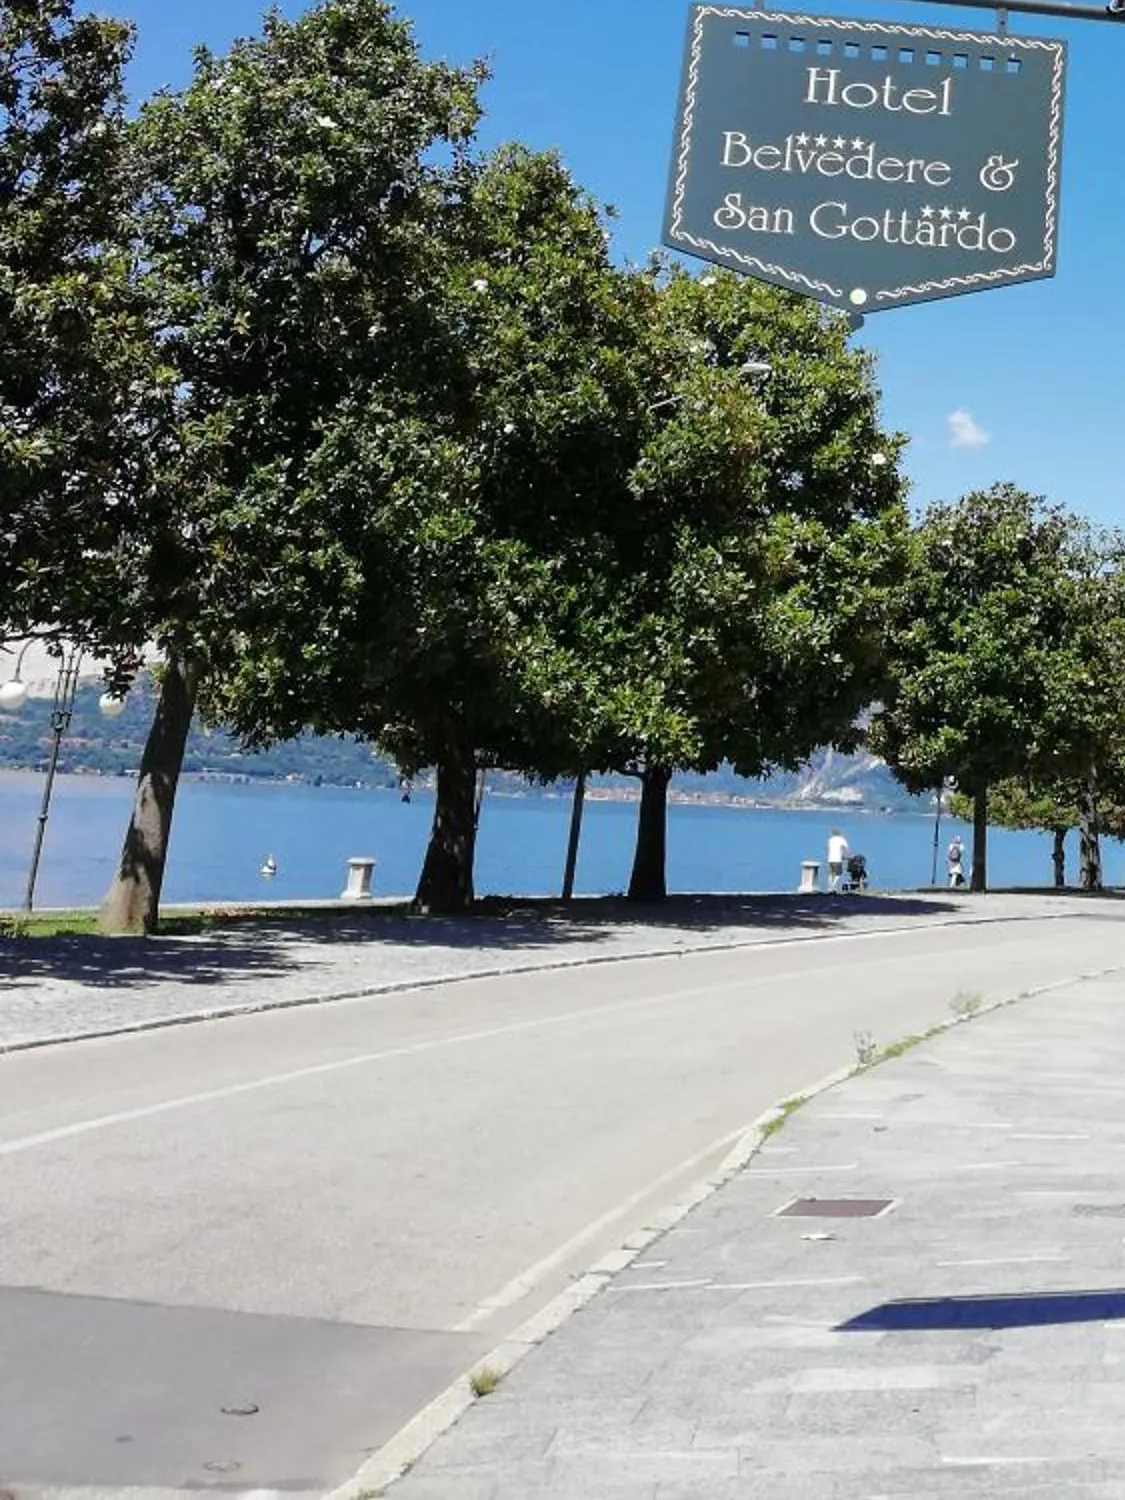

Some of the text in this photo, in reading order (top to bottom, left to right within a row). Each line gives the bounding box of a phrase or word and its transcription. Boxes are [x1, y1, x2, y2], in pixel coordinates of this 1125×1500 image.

[804, 67, 952, 116] Hotel
[719, 131, 1019, 192] Belvedere &
[713, 192, 1016, 253] San Gottardo
